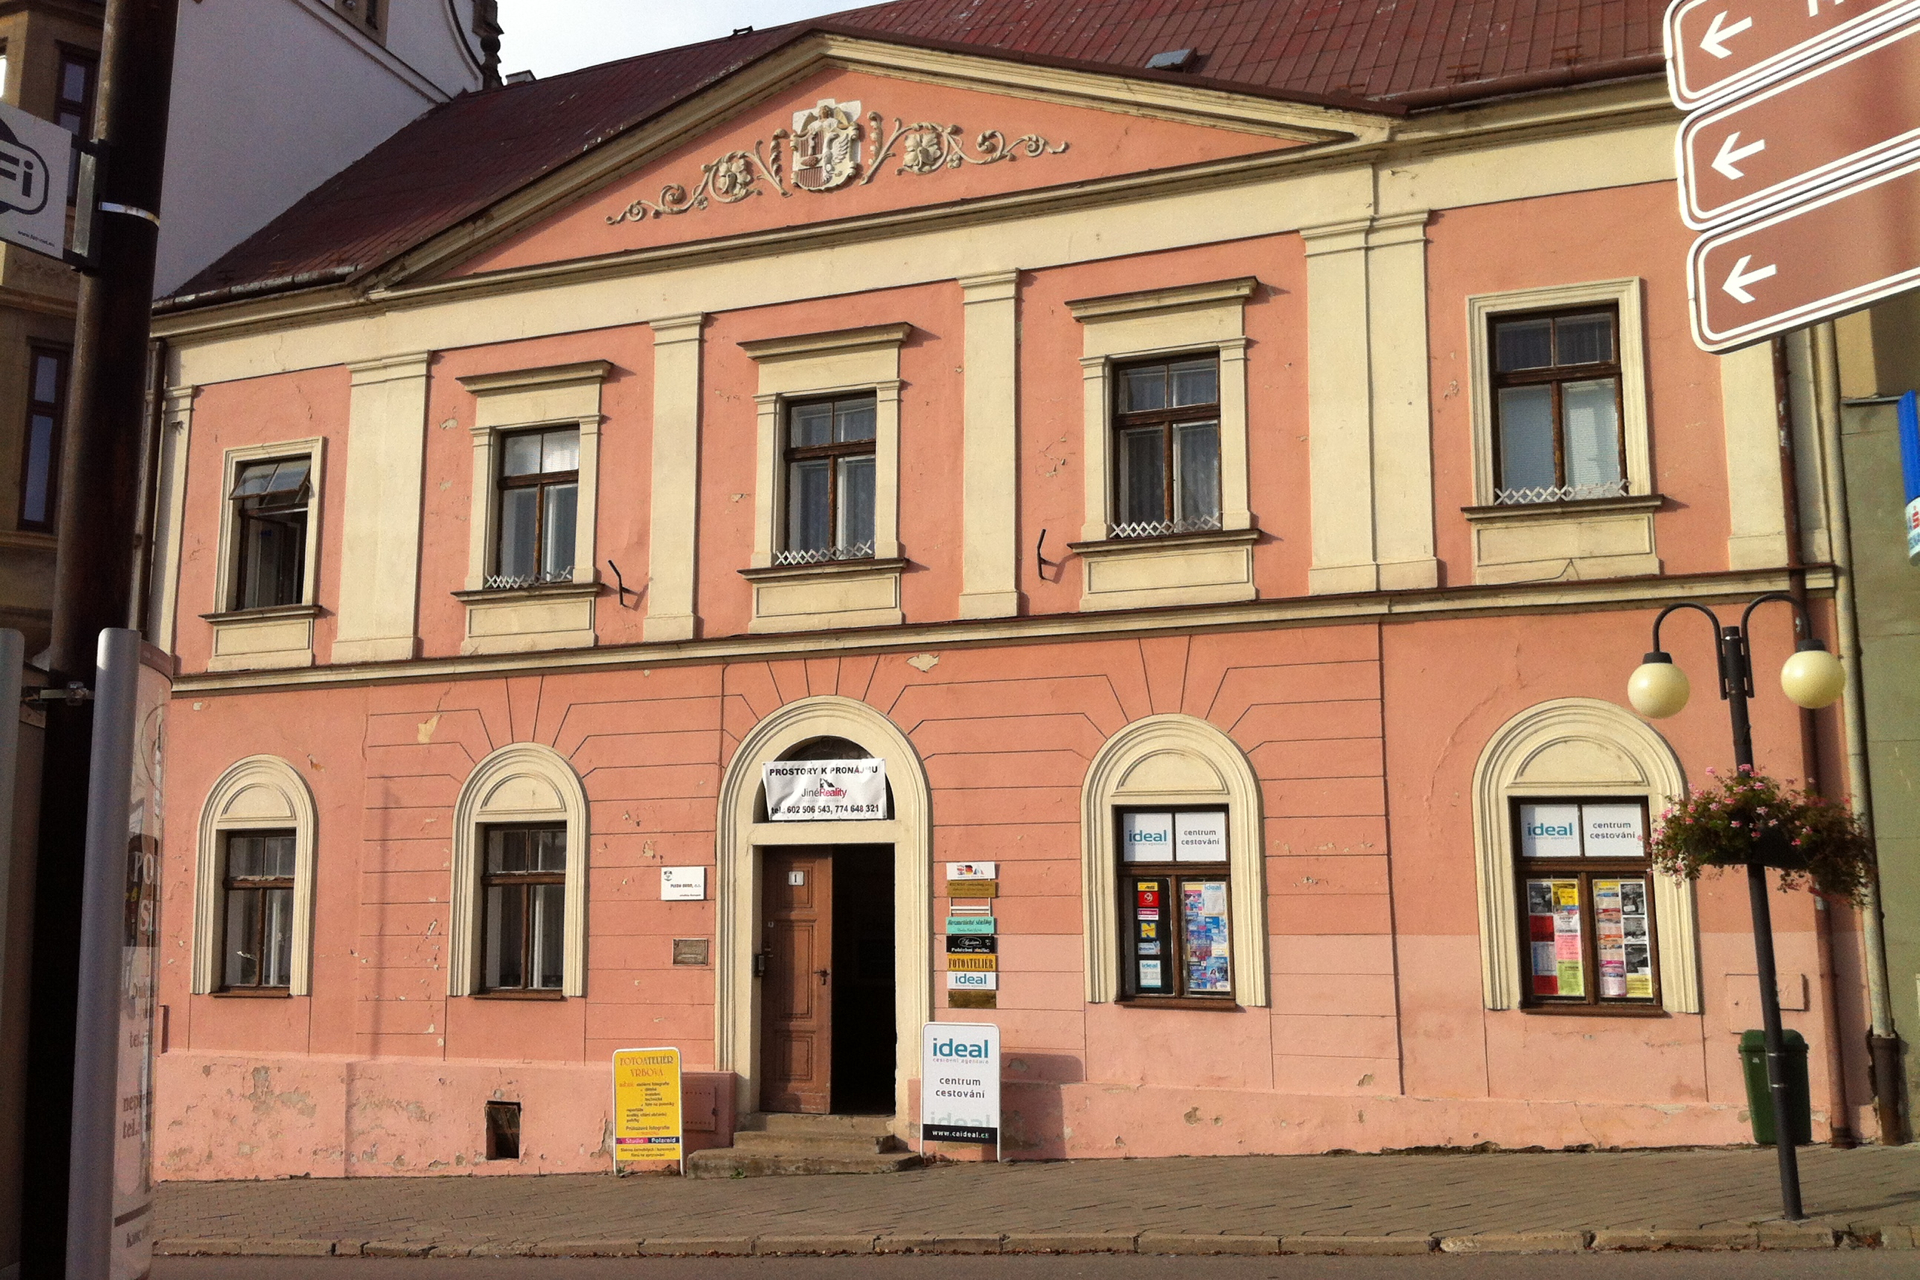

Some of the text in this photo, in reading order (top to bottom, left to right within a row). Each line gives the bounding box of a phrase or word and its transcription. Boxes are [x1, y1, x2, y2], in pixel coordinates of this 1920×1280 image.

[769, 767, 818, 776] PROSTORY
[821, 767, 828, 775] K
[801, 787, 848, 799] JinéReality
[787, 805, 800, 814] 602
[802, 805, 816, 814] 506
[835, 804, 848, 813] 774
[850, 804, 864, 813] 648
[866, 804, 879, 813] 321
[1526, 822, 1574, 836] ideal
[1592, 821, 1631, 829] centrum
[1128, 829, 1167, 843] ideal
[1589, 831, 1636, 840] cestování
[1180, 837, 1220, 846] cestování
[955, 973, 987, 985] ideal
[932, 1037, 989, 1059] ideal
[939, 1077, 981, 1086] centrum
[935, 1088, 985, 1099] cestování
